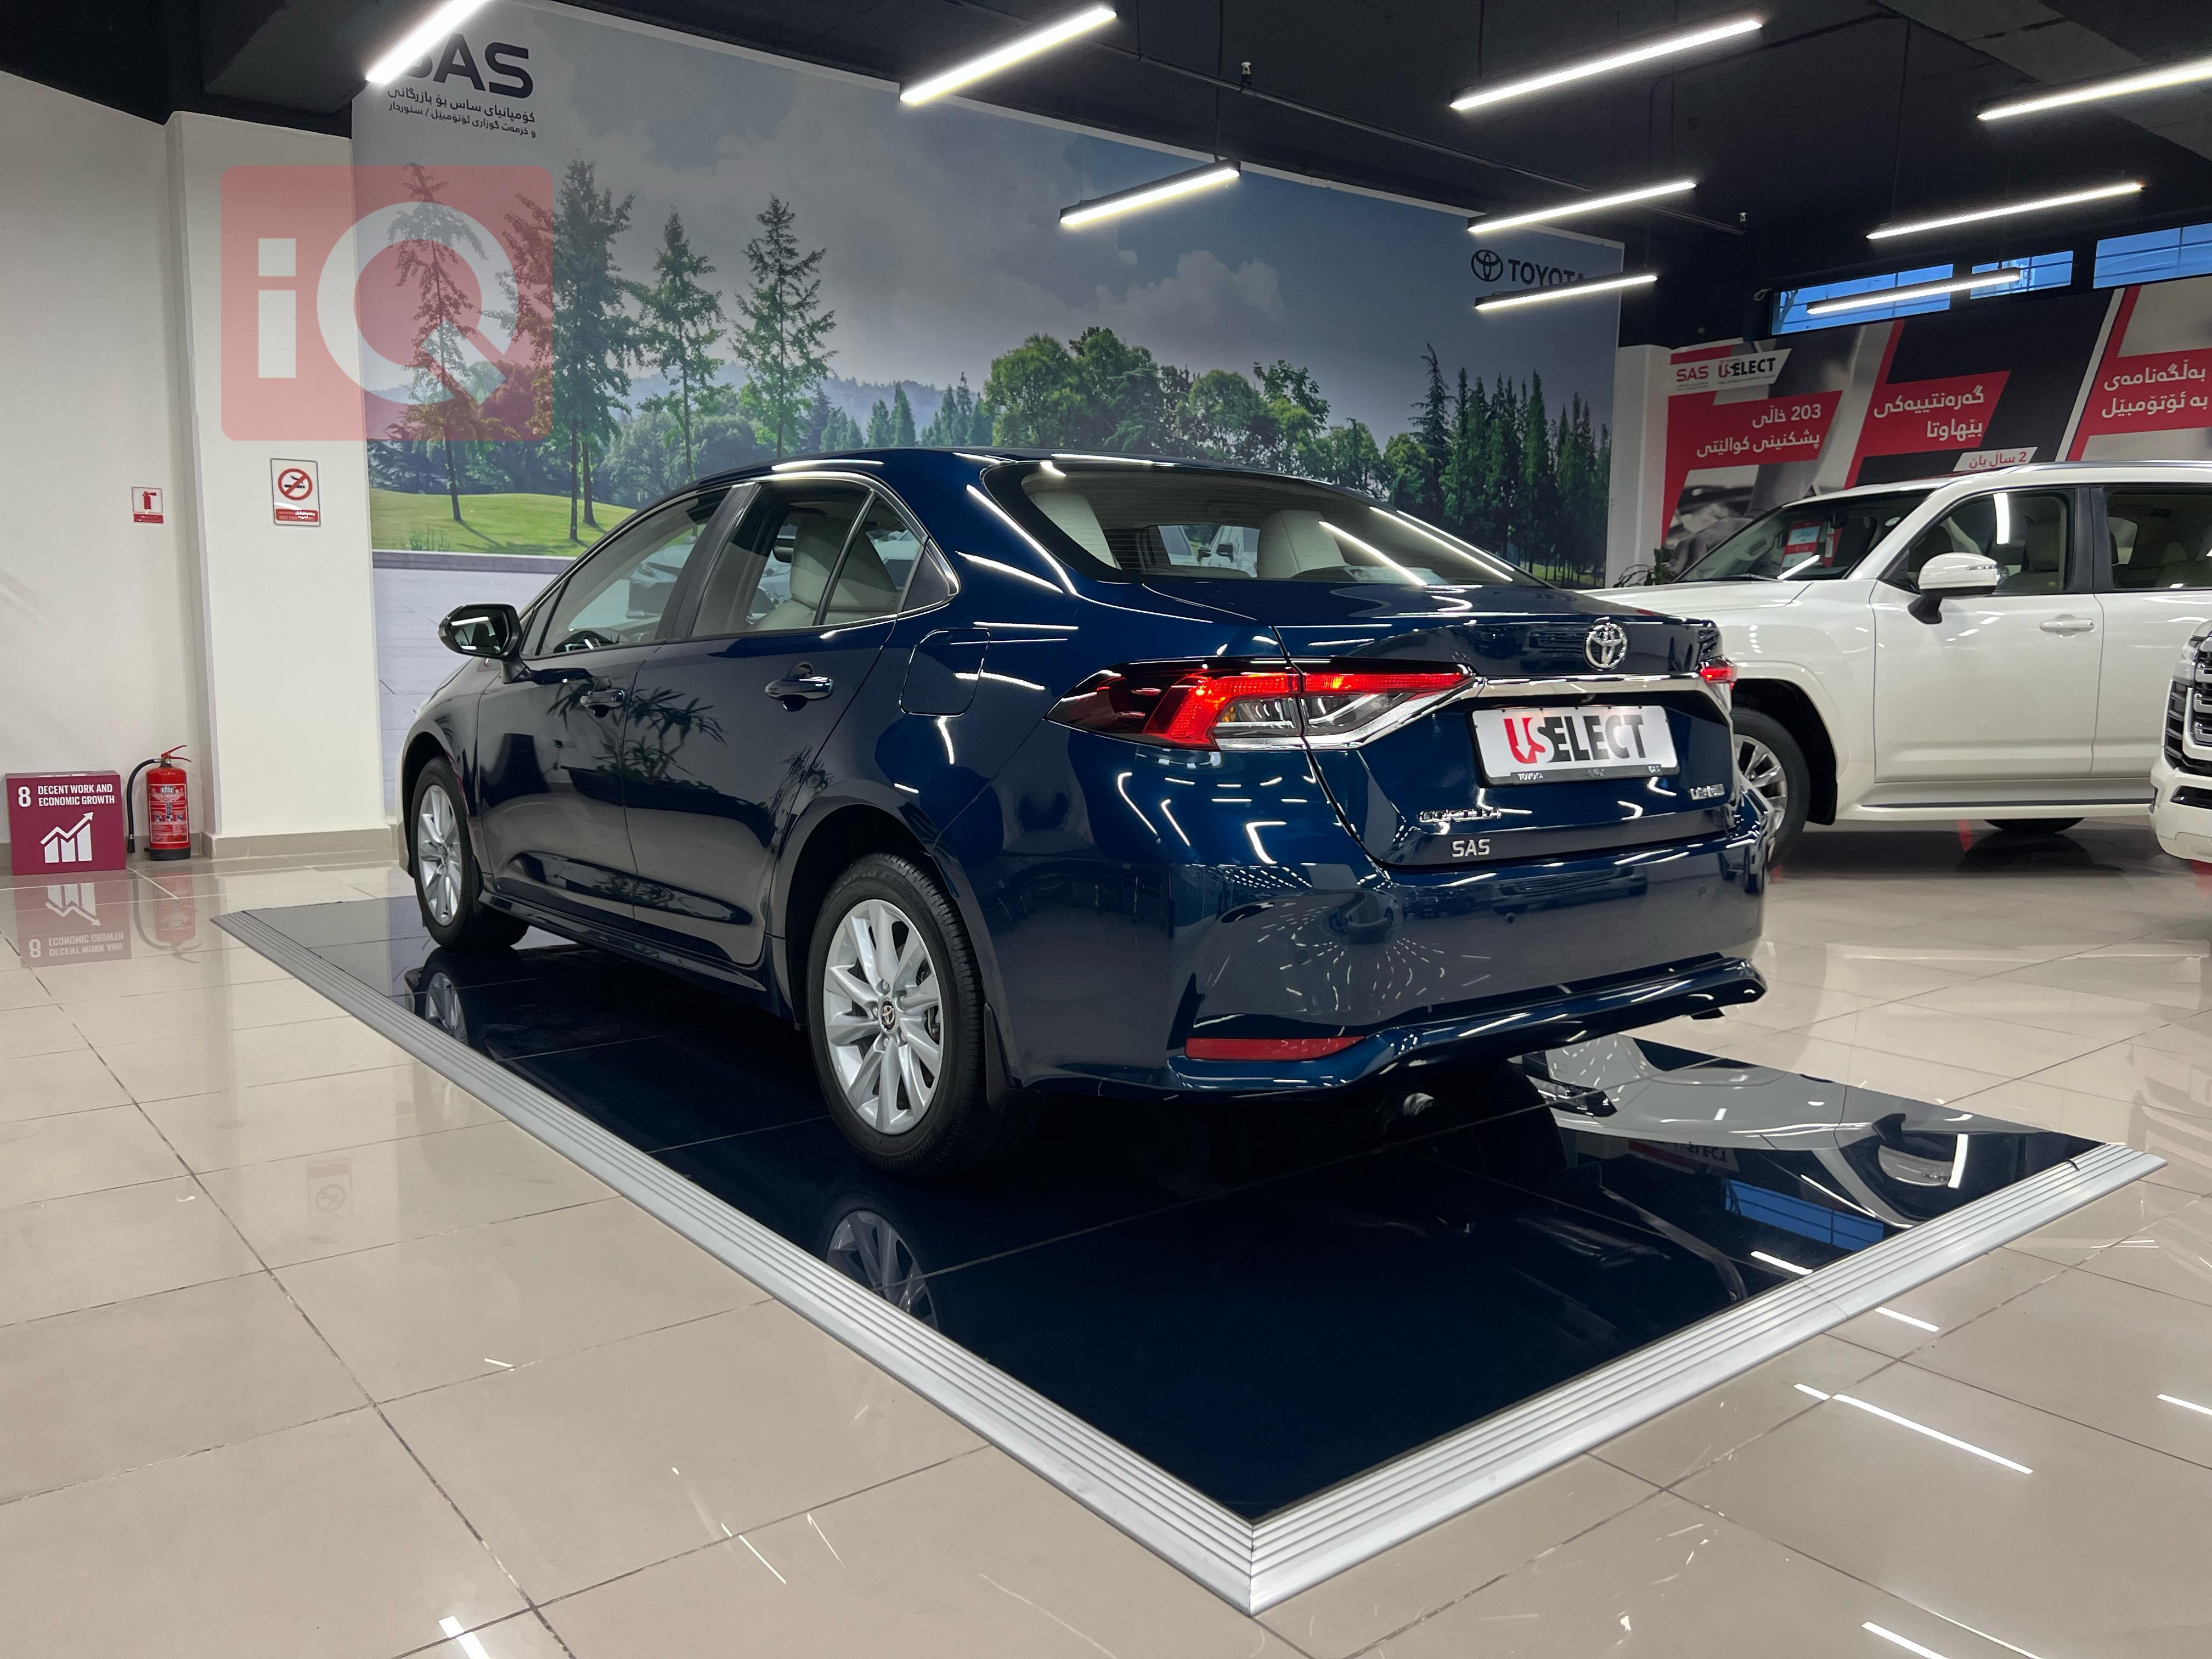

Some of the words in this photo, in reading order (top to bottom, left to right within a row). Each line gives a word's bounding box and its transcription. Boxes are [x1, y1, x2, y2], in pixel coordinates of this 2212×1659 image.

[436, 94, 447, 107] بۆ
[450, 99, 481, 111] ساس
[531, 129, 536, 138] و
[1677, 365, 1708, 382] SAS
[2190, 396, 2208, 410] بە
[1791, 404, 1821, 421] 203
[1927, 418, 1983, 442] بێهاوتا
[2018, 452, 2027, 462] 2
[1503, 715, 1646, 764] USELECT
[38, 785, 69, 795] DECENT
[70, 785, 94, 794] WORK
[97, 783, 113, 793] AND
[18, 786, 31, 807] 8
[38, 797, 80, 806] ECONOMIC
[82, 795, 115, 805] GROWTH
[1452, 838, 1491, 857] SAS
